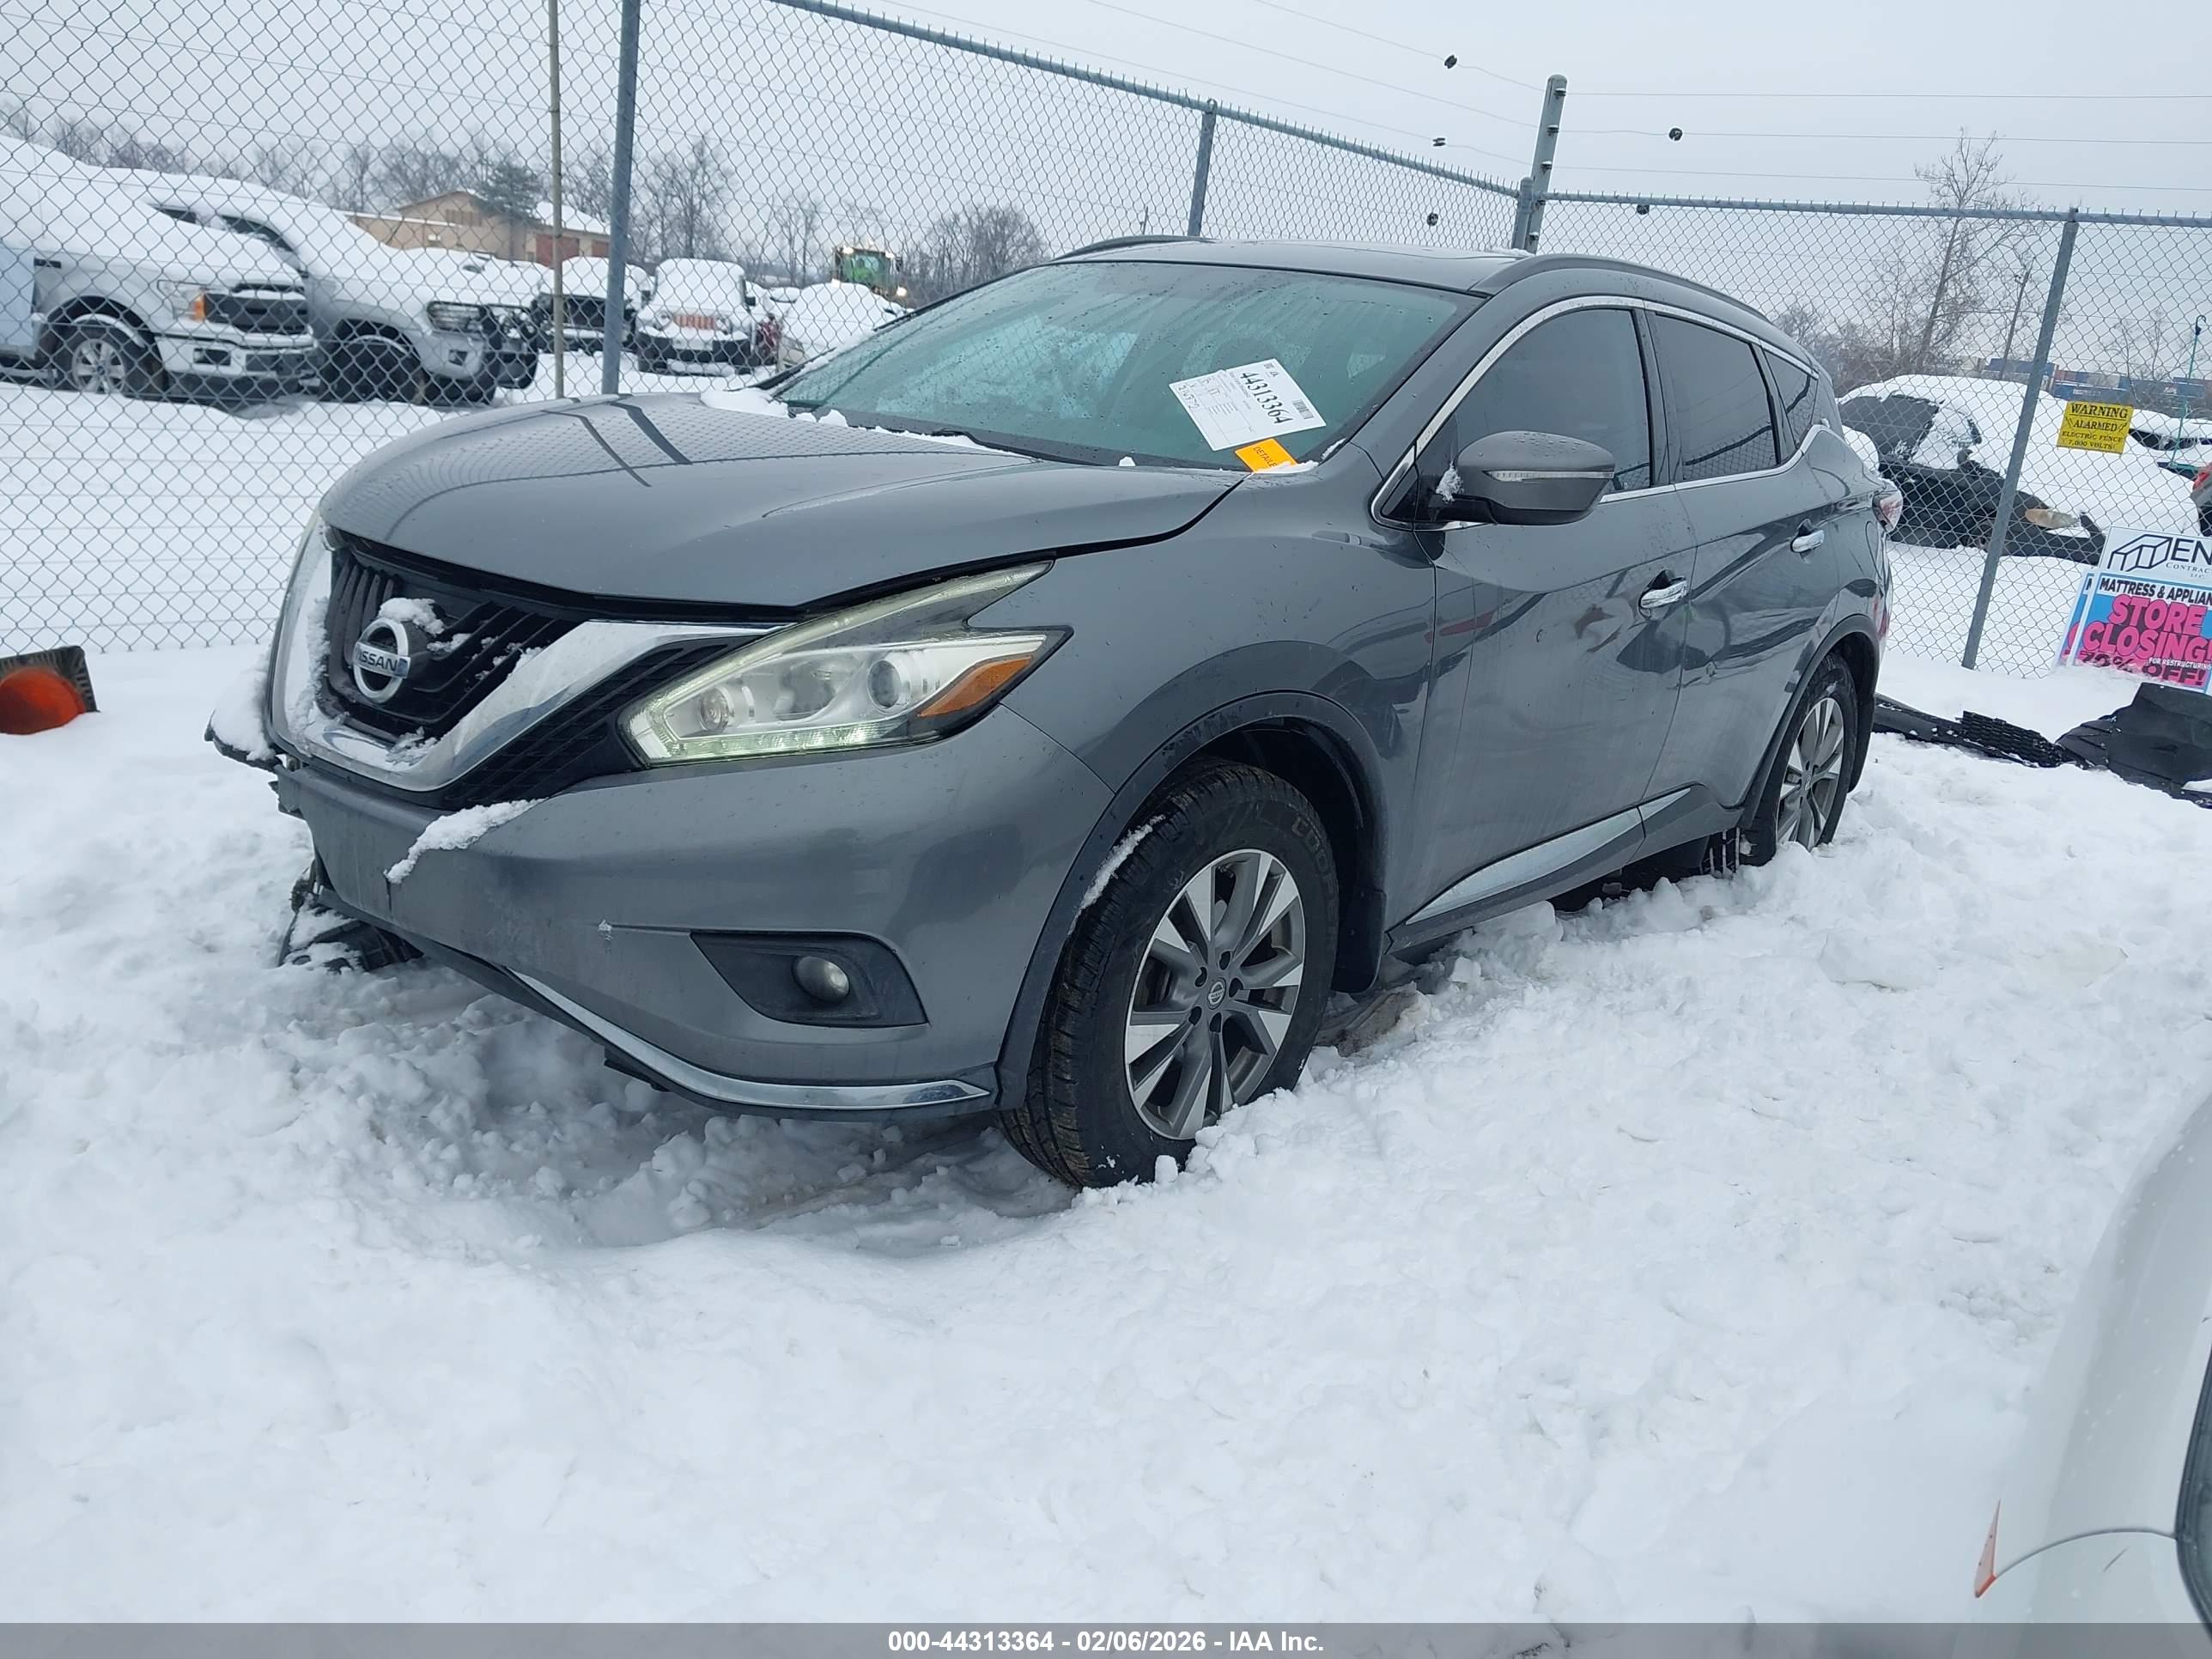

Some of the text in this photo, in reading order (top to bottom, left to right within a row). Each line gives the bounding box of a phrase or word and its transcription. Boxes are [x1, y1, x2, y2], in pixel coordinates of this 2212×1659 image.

[1240, 372, 1293, 424] 44313364
[2071, 404, 2129, 418] WARNING
[2073, 419, 2118, 432] ALARMED
[2062, 431, 2098, 440] ELECTRIC
[2166, 562, 2212, 574] CONTRAC
[2100, 578, 2158, 599] MATTRESS
[2157, 586, 2166, 599] &
[2109, 594, 2208, 635] STORE
[354, 647, 398, 672] ISSAN
[2162, 659, 2212, 670] RESTRUCTURING
[2142, 664, 2207, 685] OFF!
